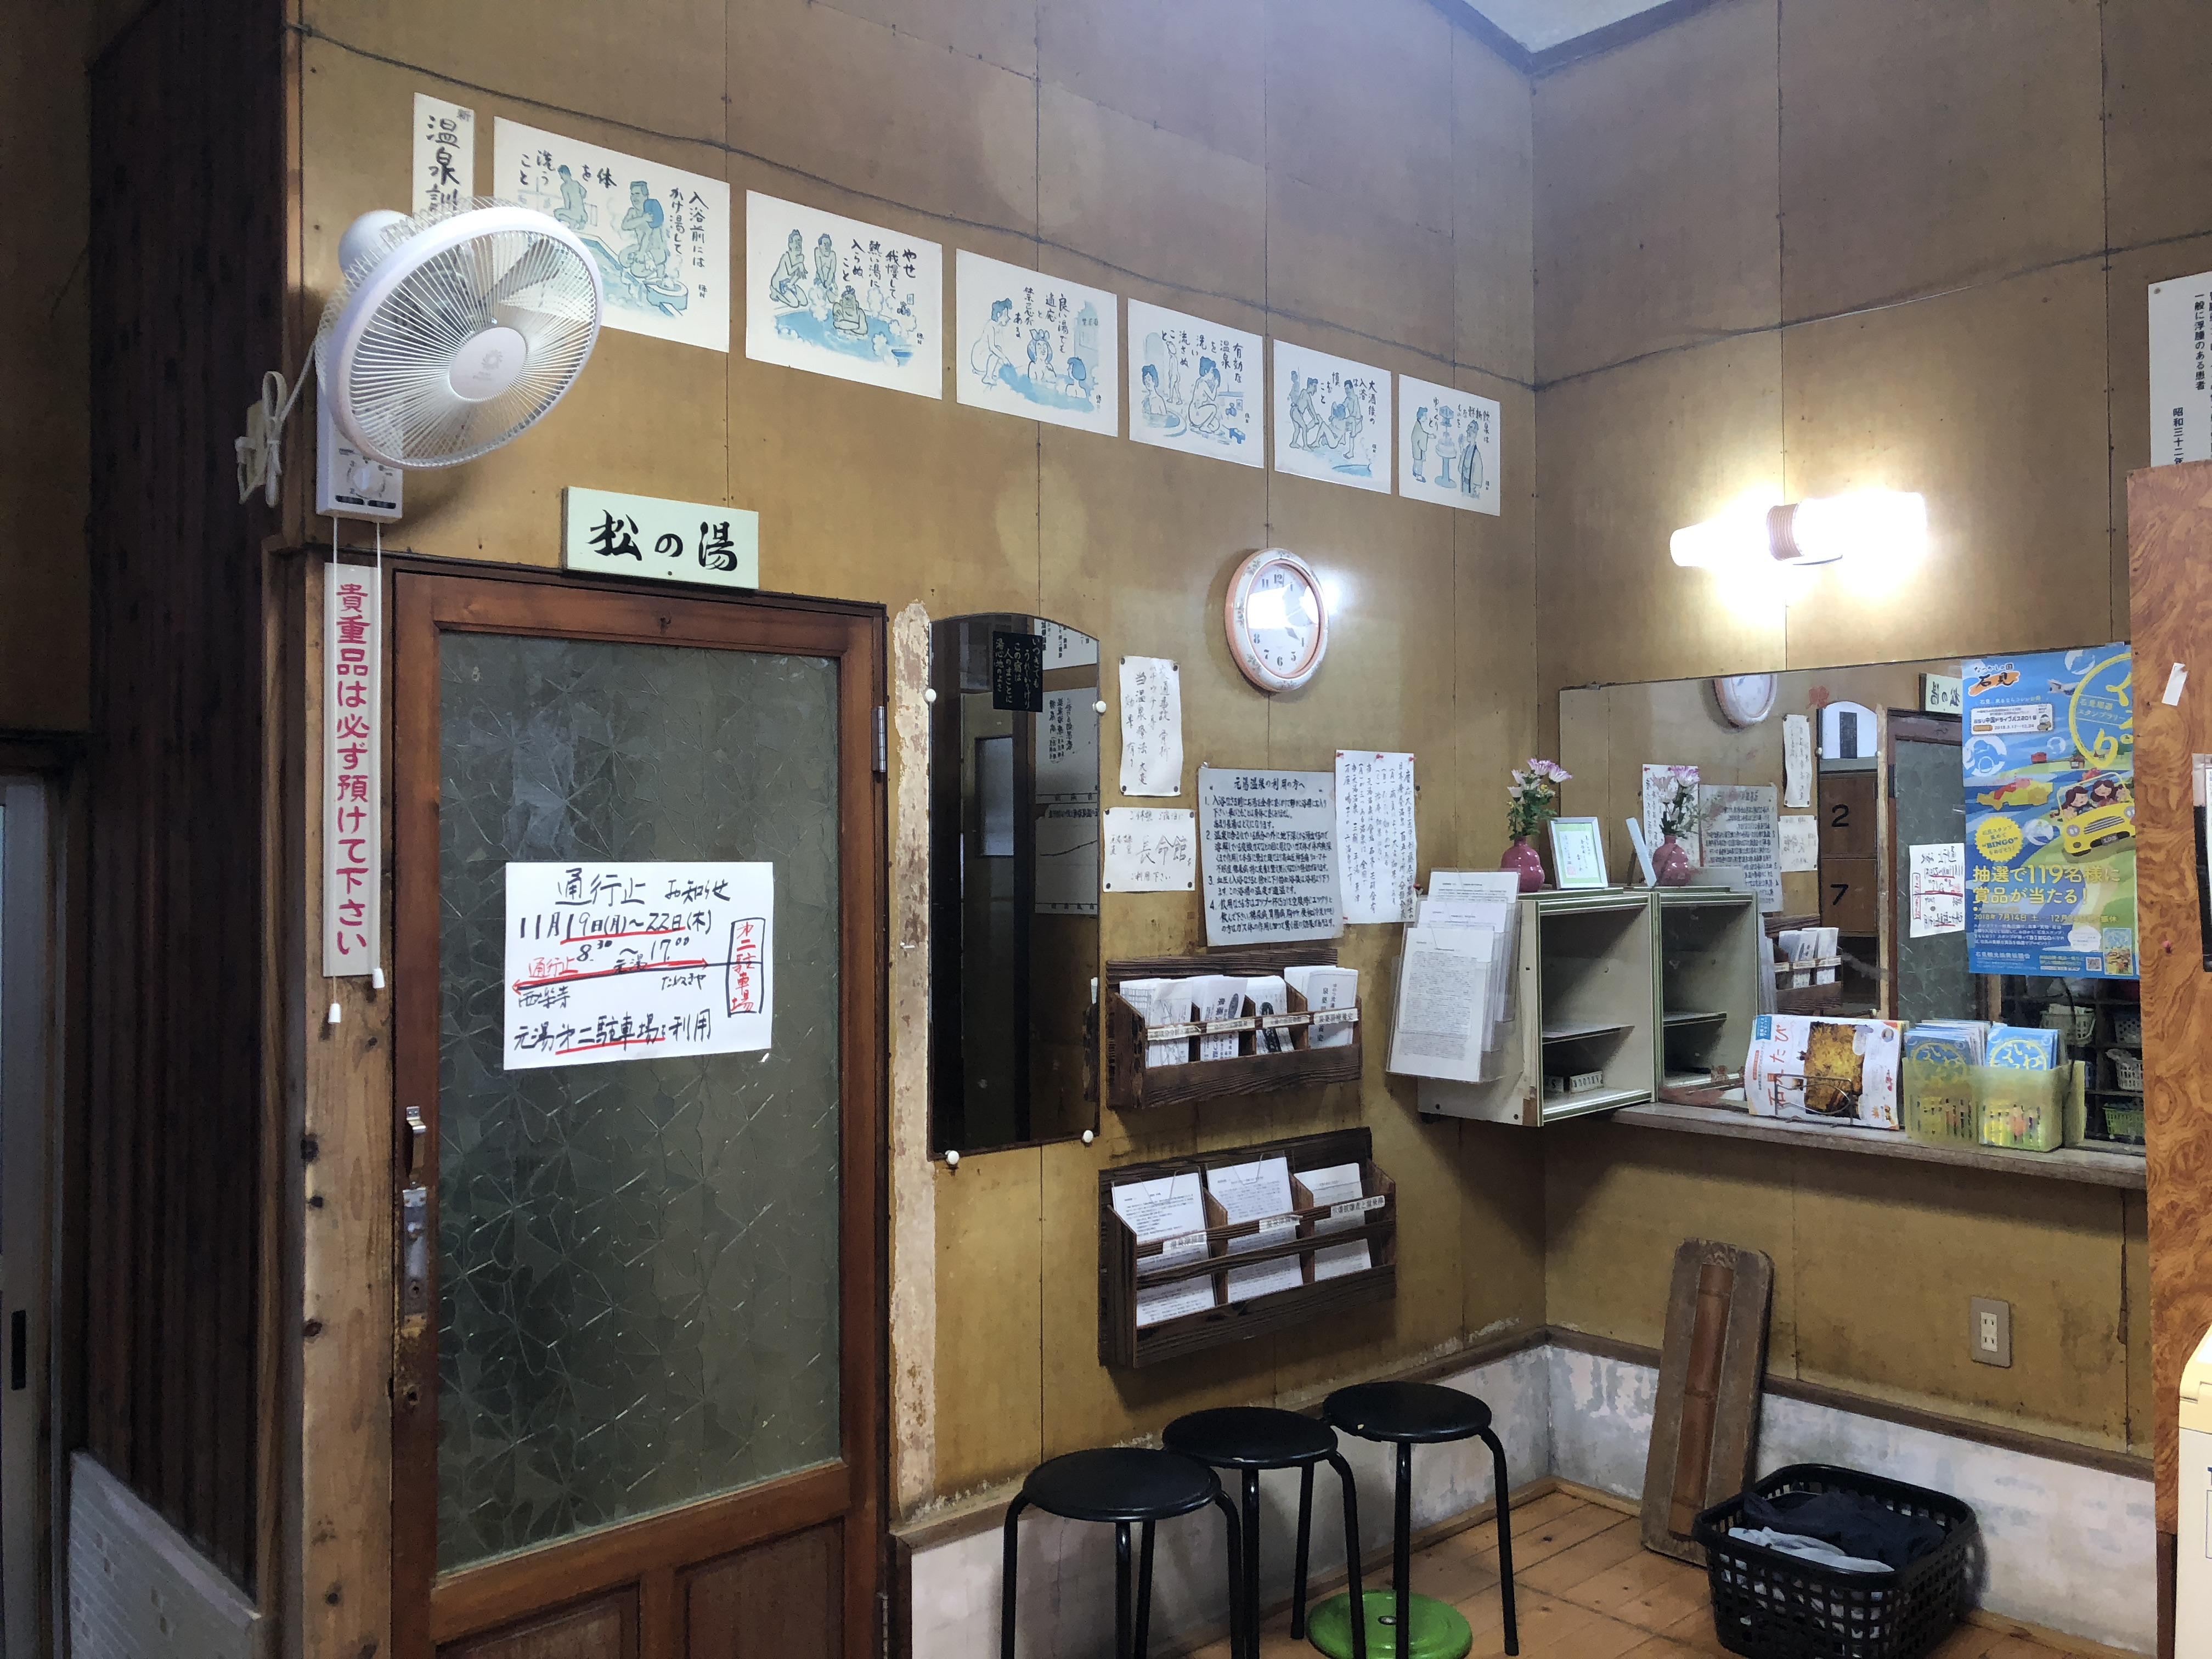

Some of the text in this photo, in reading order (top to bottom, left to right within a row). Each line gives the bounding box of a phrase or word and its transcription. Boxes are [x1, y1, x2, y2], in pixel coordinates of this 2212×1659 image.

[537, 149, 556, 185] 洗う
[669, 187, 685, 256] かけ湯して
[689, 191, 709, 269] 入浴前には
[843, 258, 850, 282] こと
[851, 239, 865, 279] 入らぬ
[868, 240, 883, 288] 熱い湯に
[885, 249, 899, 300] 我慢して
[902, 249, 917, 279] やせ
[1058, 293, 1070, 354] 良い湯でも
[1220, 340, 1232, 369] 温泉
[586, 509, 738, 572] 松の湯
[1277, 656, 1283, 667] 6
[1976, 672, 2016, 687] 石見
[336, 583, 370, 955] 貴重品は必ず預けて下さい
[1831, 804, 1850, 828] 2
[555, 867, 646, 907] 通行止
[1972, 864, 2121, 884] 抽選で119名様に
[1830, 883, 1849, 906] 7
